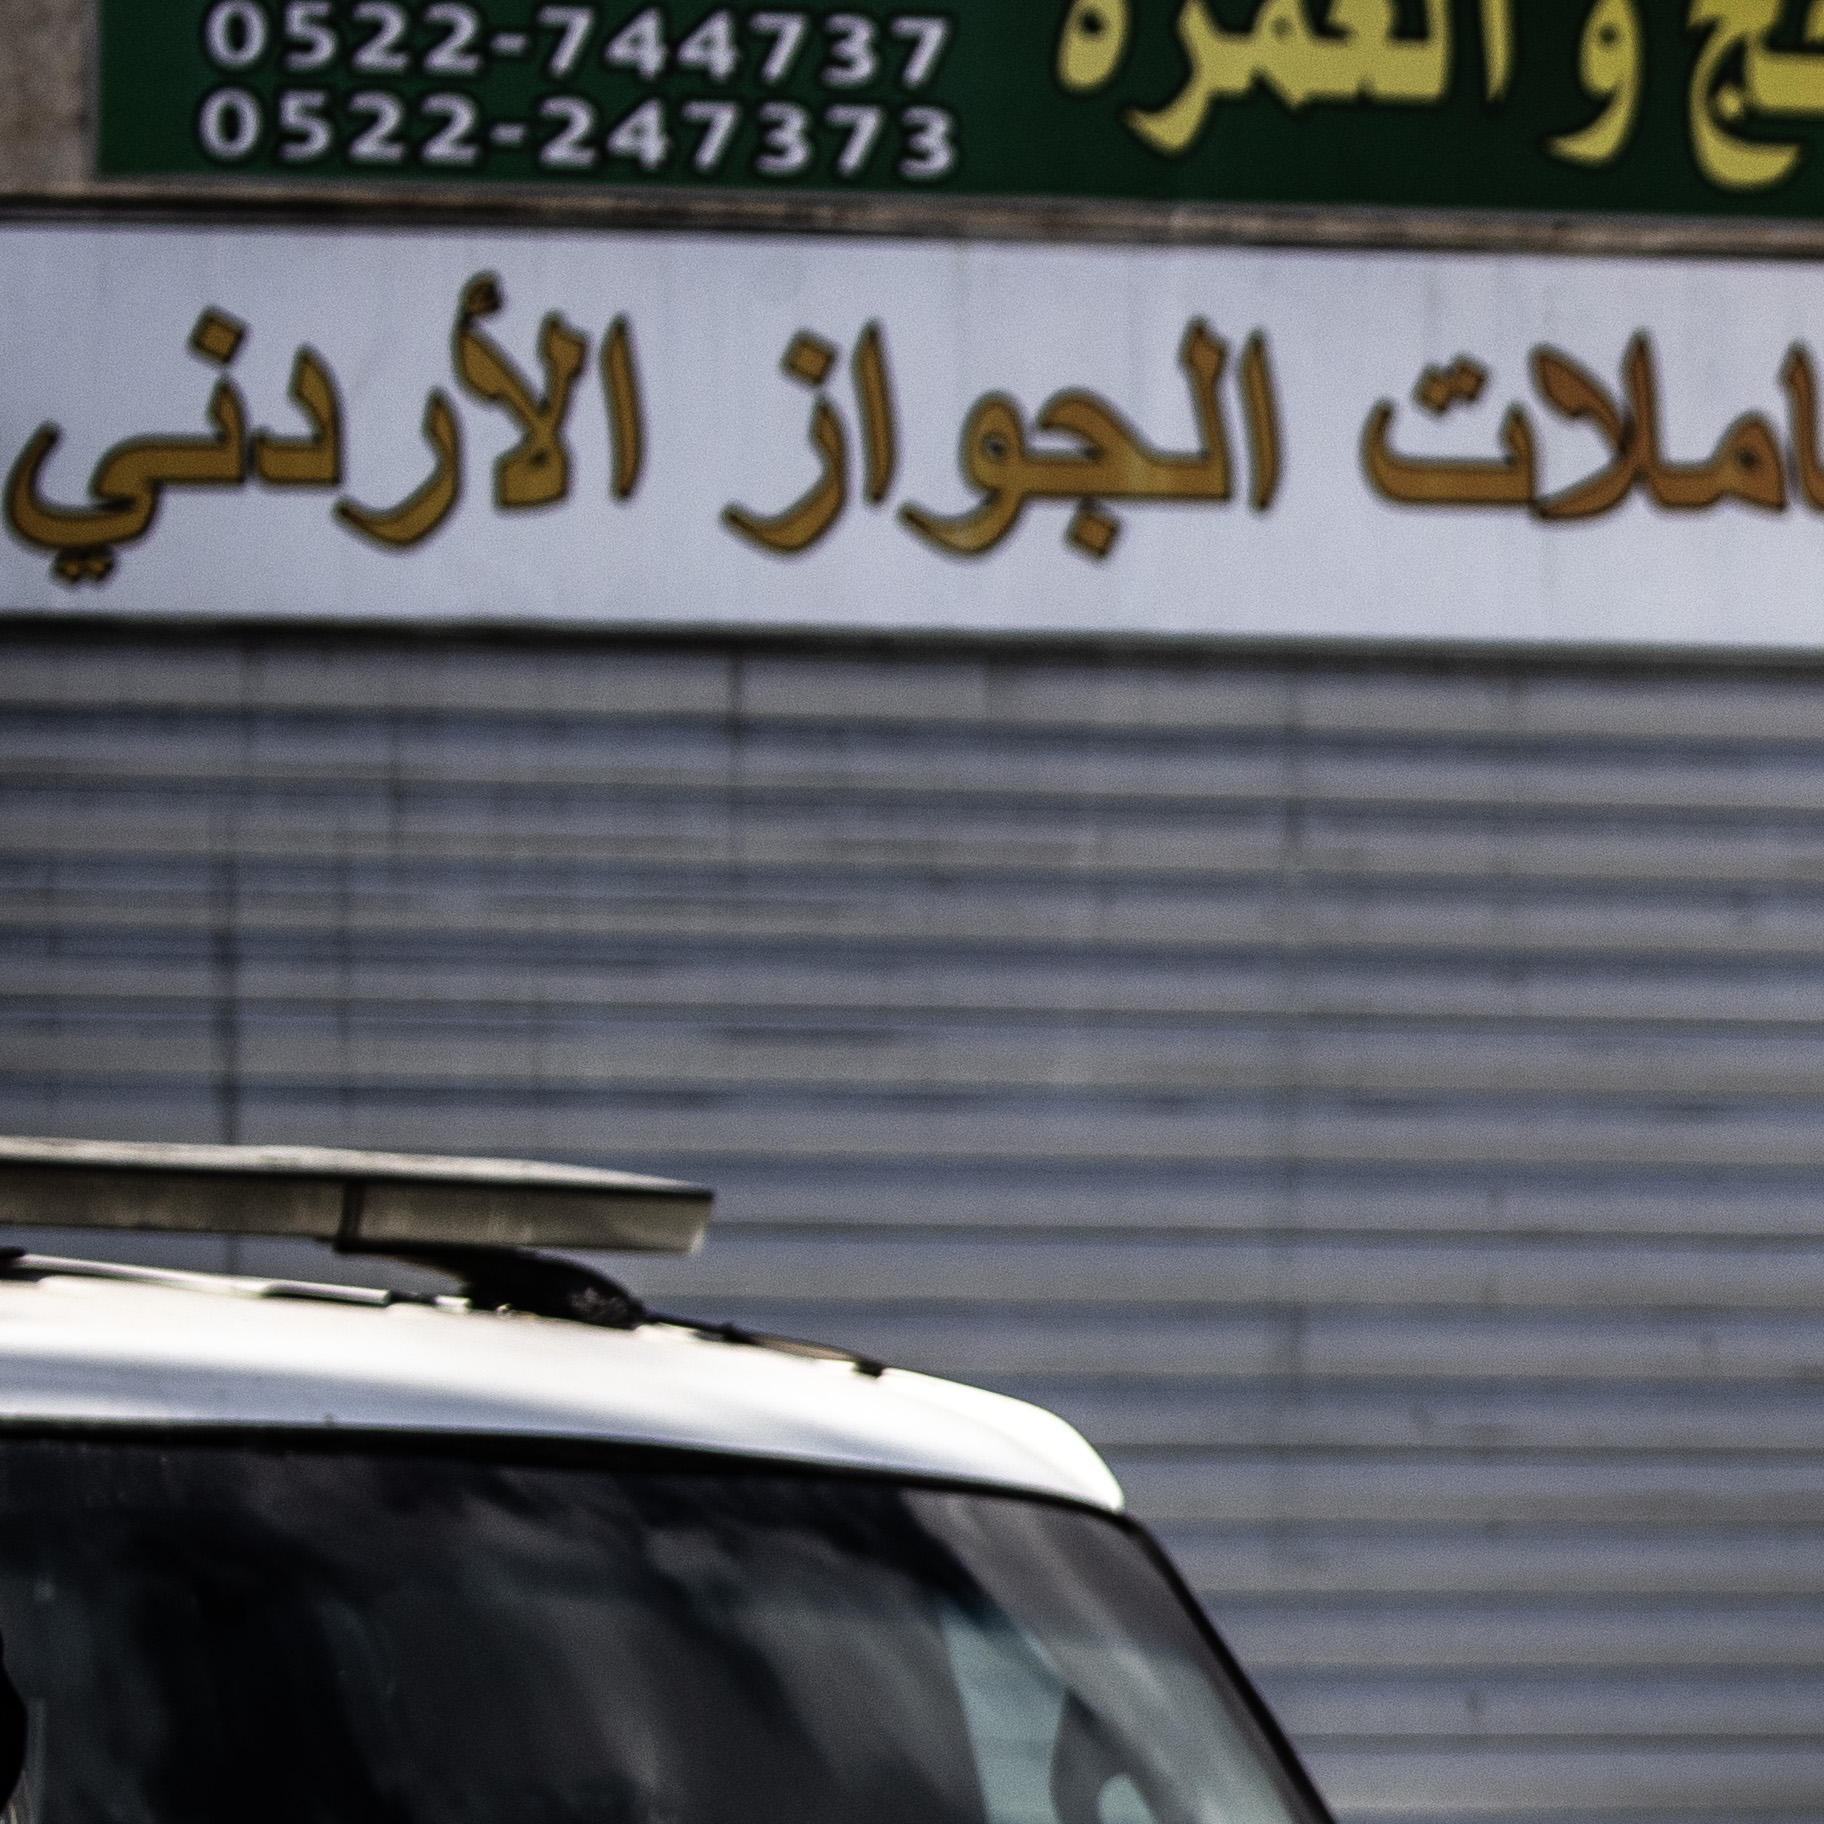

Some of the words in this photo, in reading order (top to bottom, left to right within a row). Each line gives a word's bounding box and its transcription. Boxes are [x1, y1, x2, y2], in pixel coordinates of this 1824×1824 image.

[207, 0, 950, 86] 0522-744737
[1544, 0, 1643, 165] و
[199, 87, 957, 180] 0522-247373
[4, 268, 646, 588] الأردني
[722, 314, 1284, 562] الجواز
